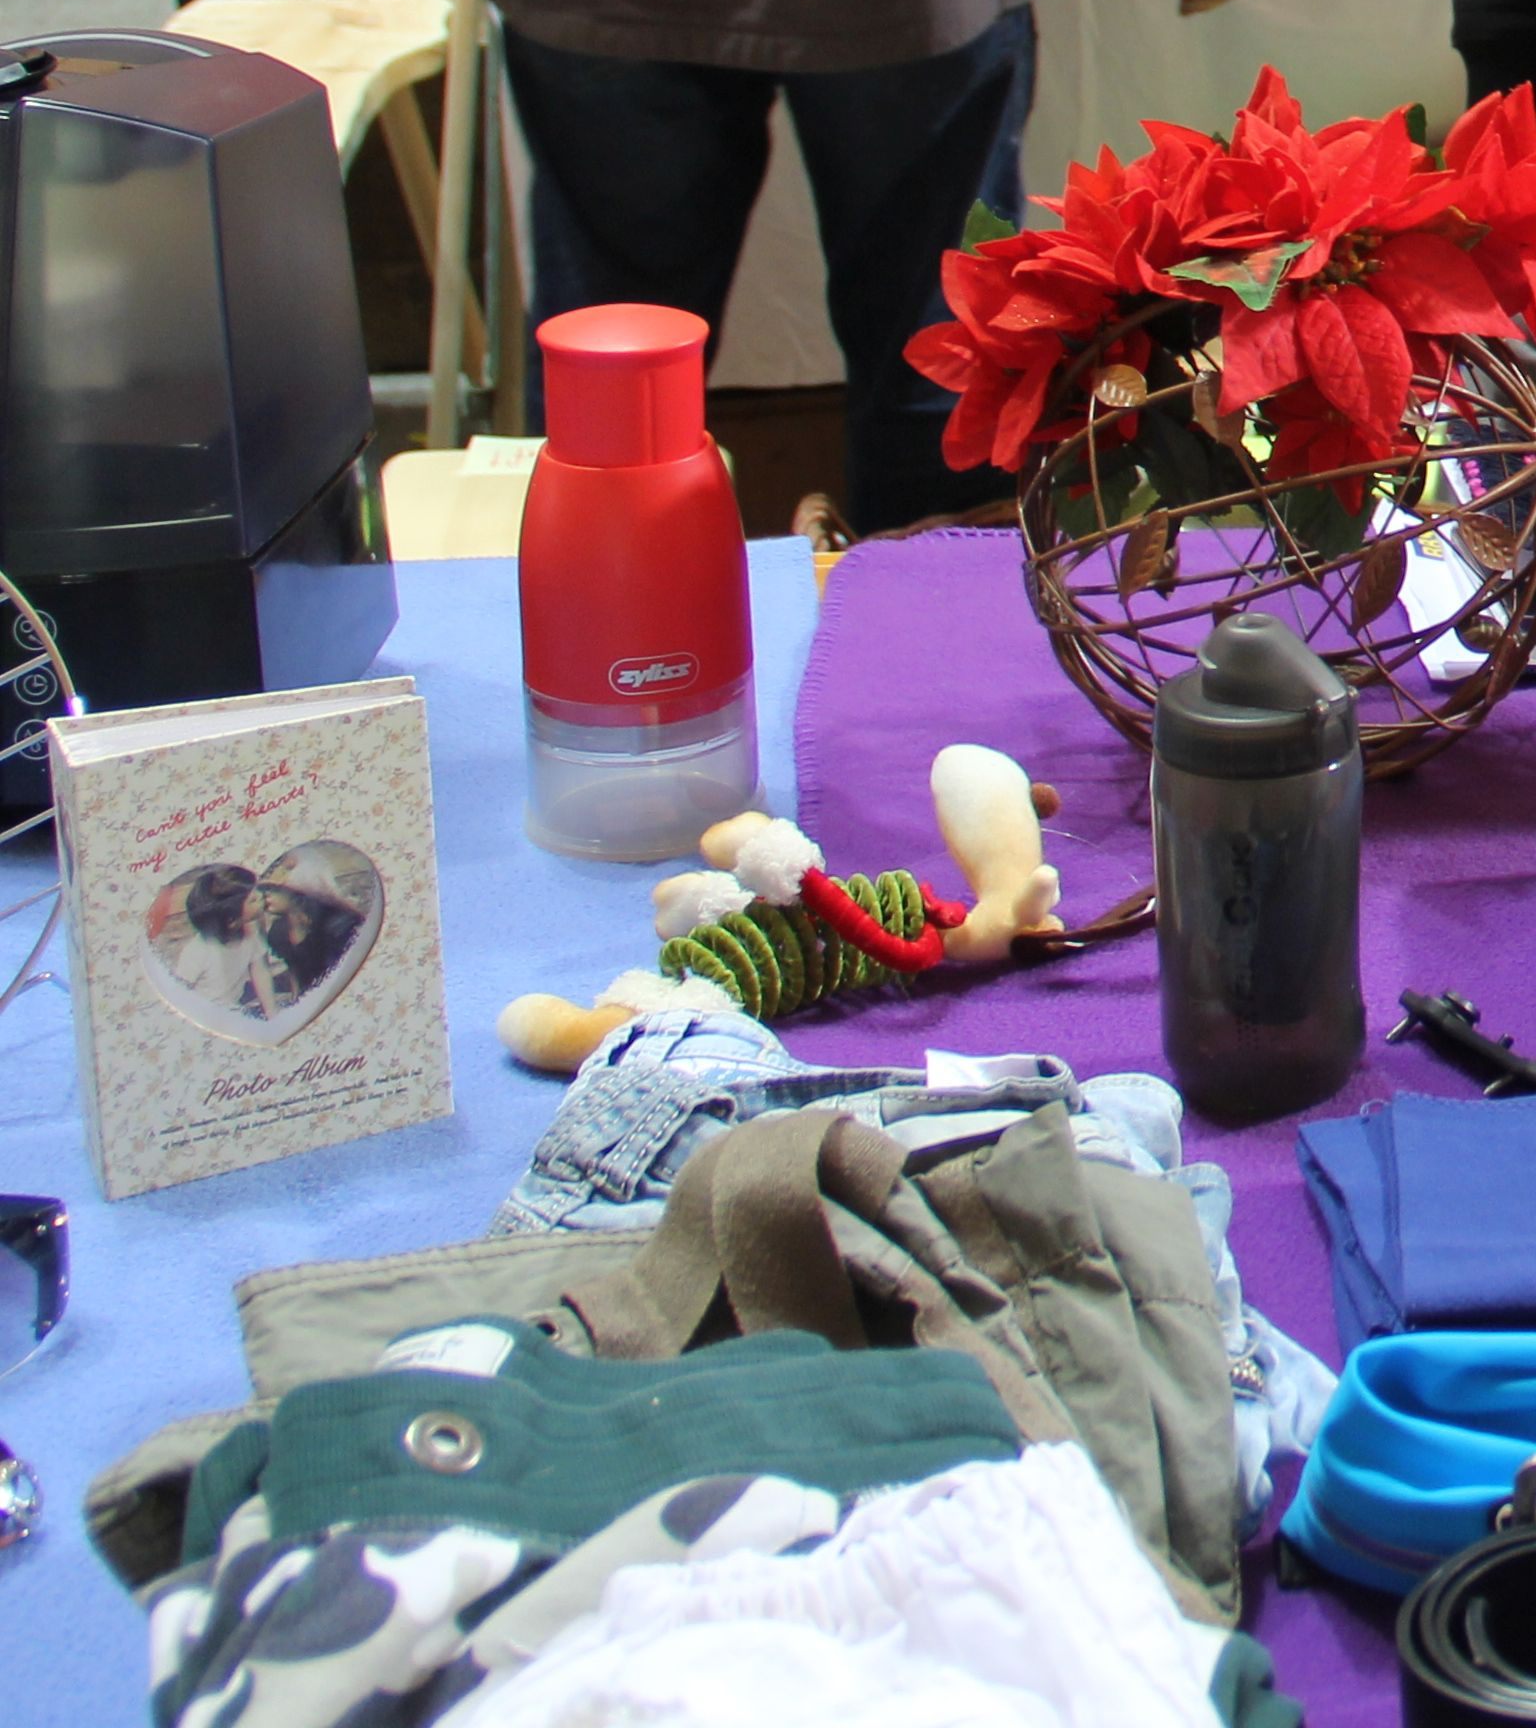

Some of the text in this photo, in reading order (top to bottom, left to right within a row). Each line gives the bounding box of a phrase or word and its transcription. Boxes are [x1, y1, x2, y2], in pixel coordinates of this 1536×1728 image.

[617, 661, 692, 688] zyliss
[195, 791, 233, 822] you
[245, 758, 291, 798] feel
[128, 850, 168, 873] my
[175, 820, 233, 852] cutie
[203, 1053, 368, 1106] Photo Album
